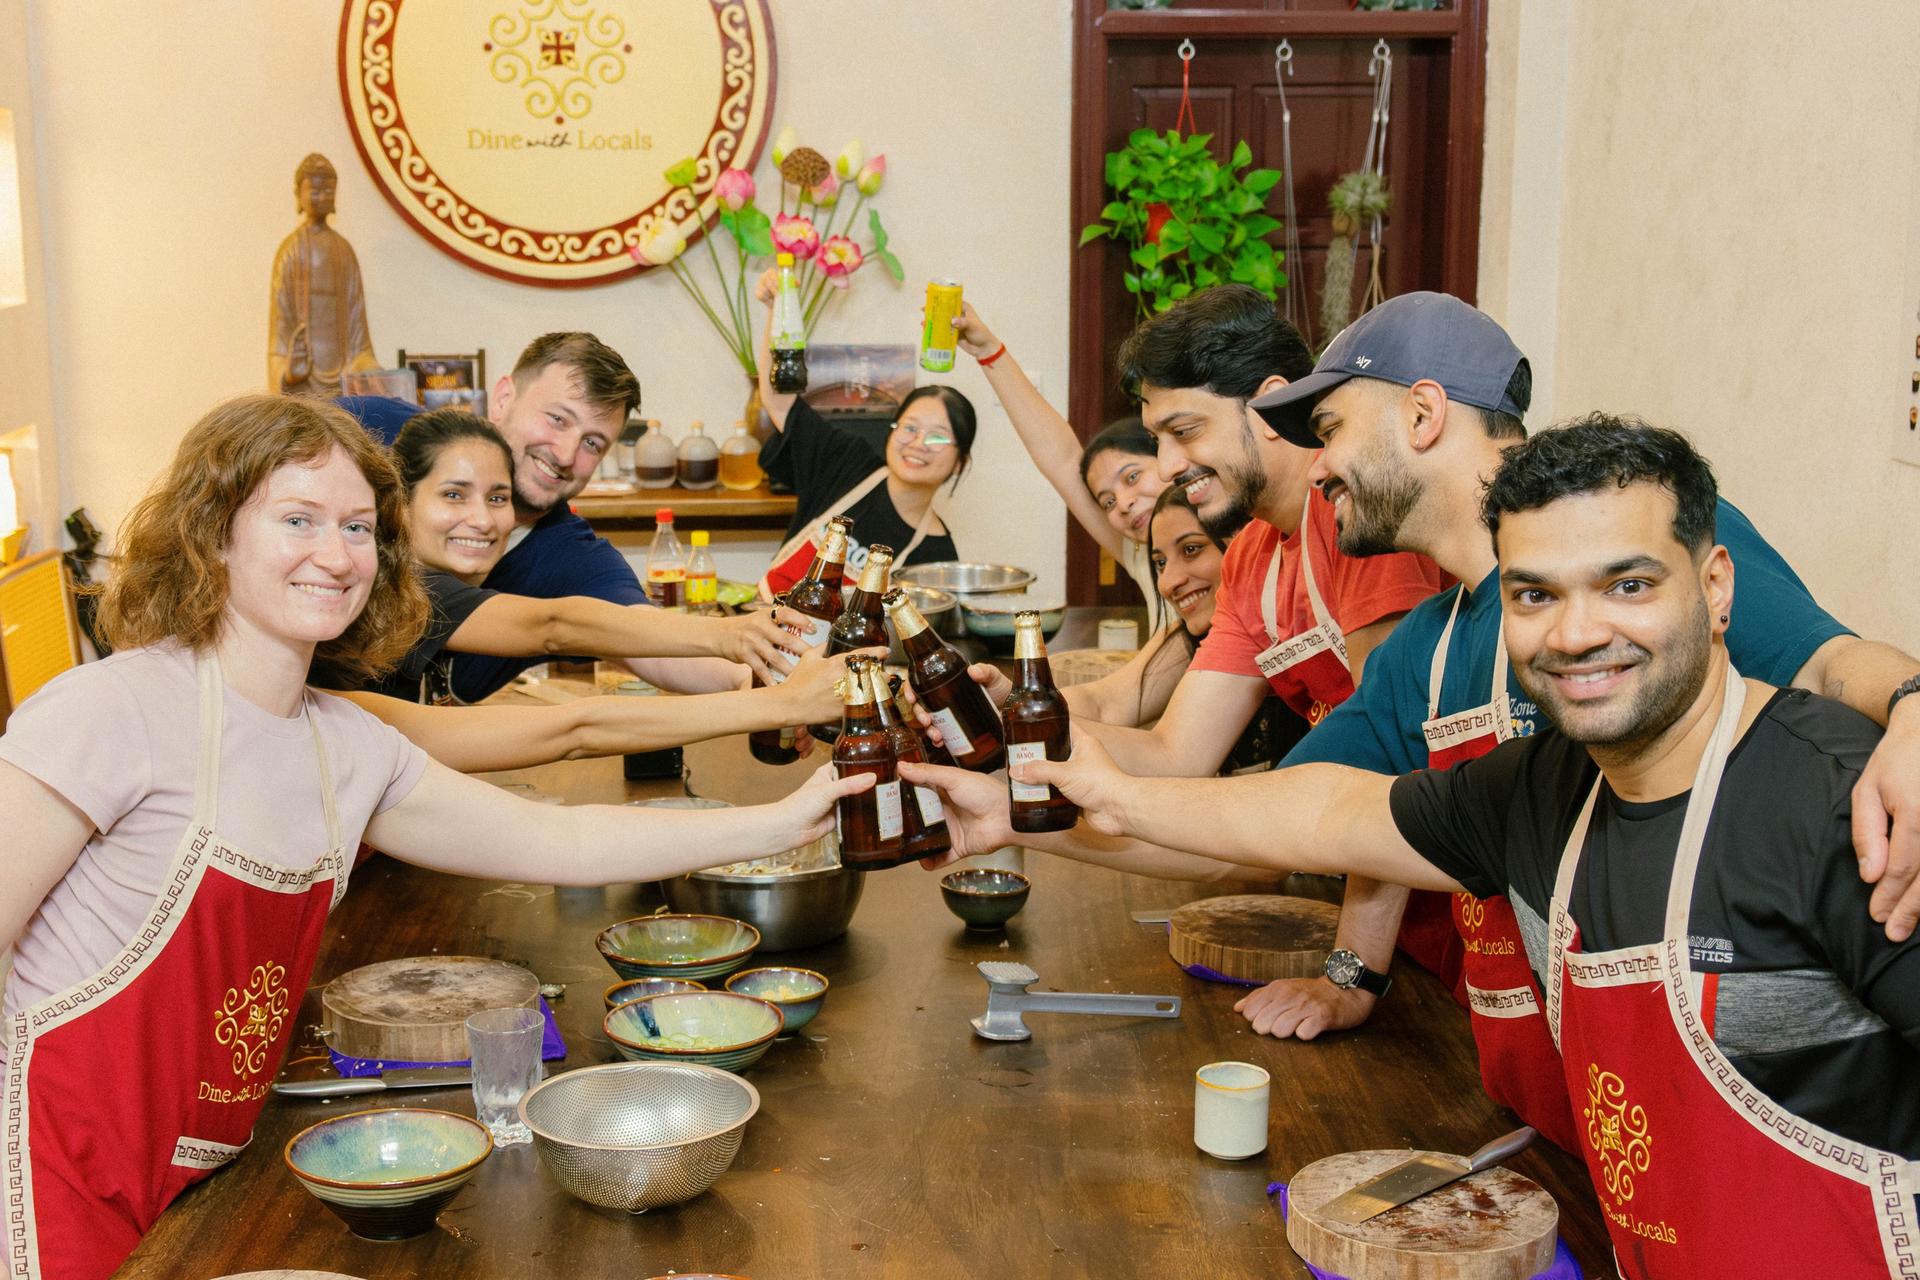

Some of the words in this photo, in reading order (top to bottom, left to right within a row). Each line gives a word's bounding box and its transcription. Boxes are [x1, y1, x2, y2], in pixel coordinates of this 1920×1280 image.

[467, 128, 523, 150] Dine
[526, 132, 572, 149] with
[577, 128, 653, 150] Locals
[1479, 936, 1516, 955] Locals
[198, 1081, 232, 1103] Dine
[1629, 1213, 1677, 1245] Locals
